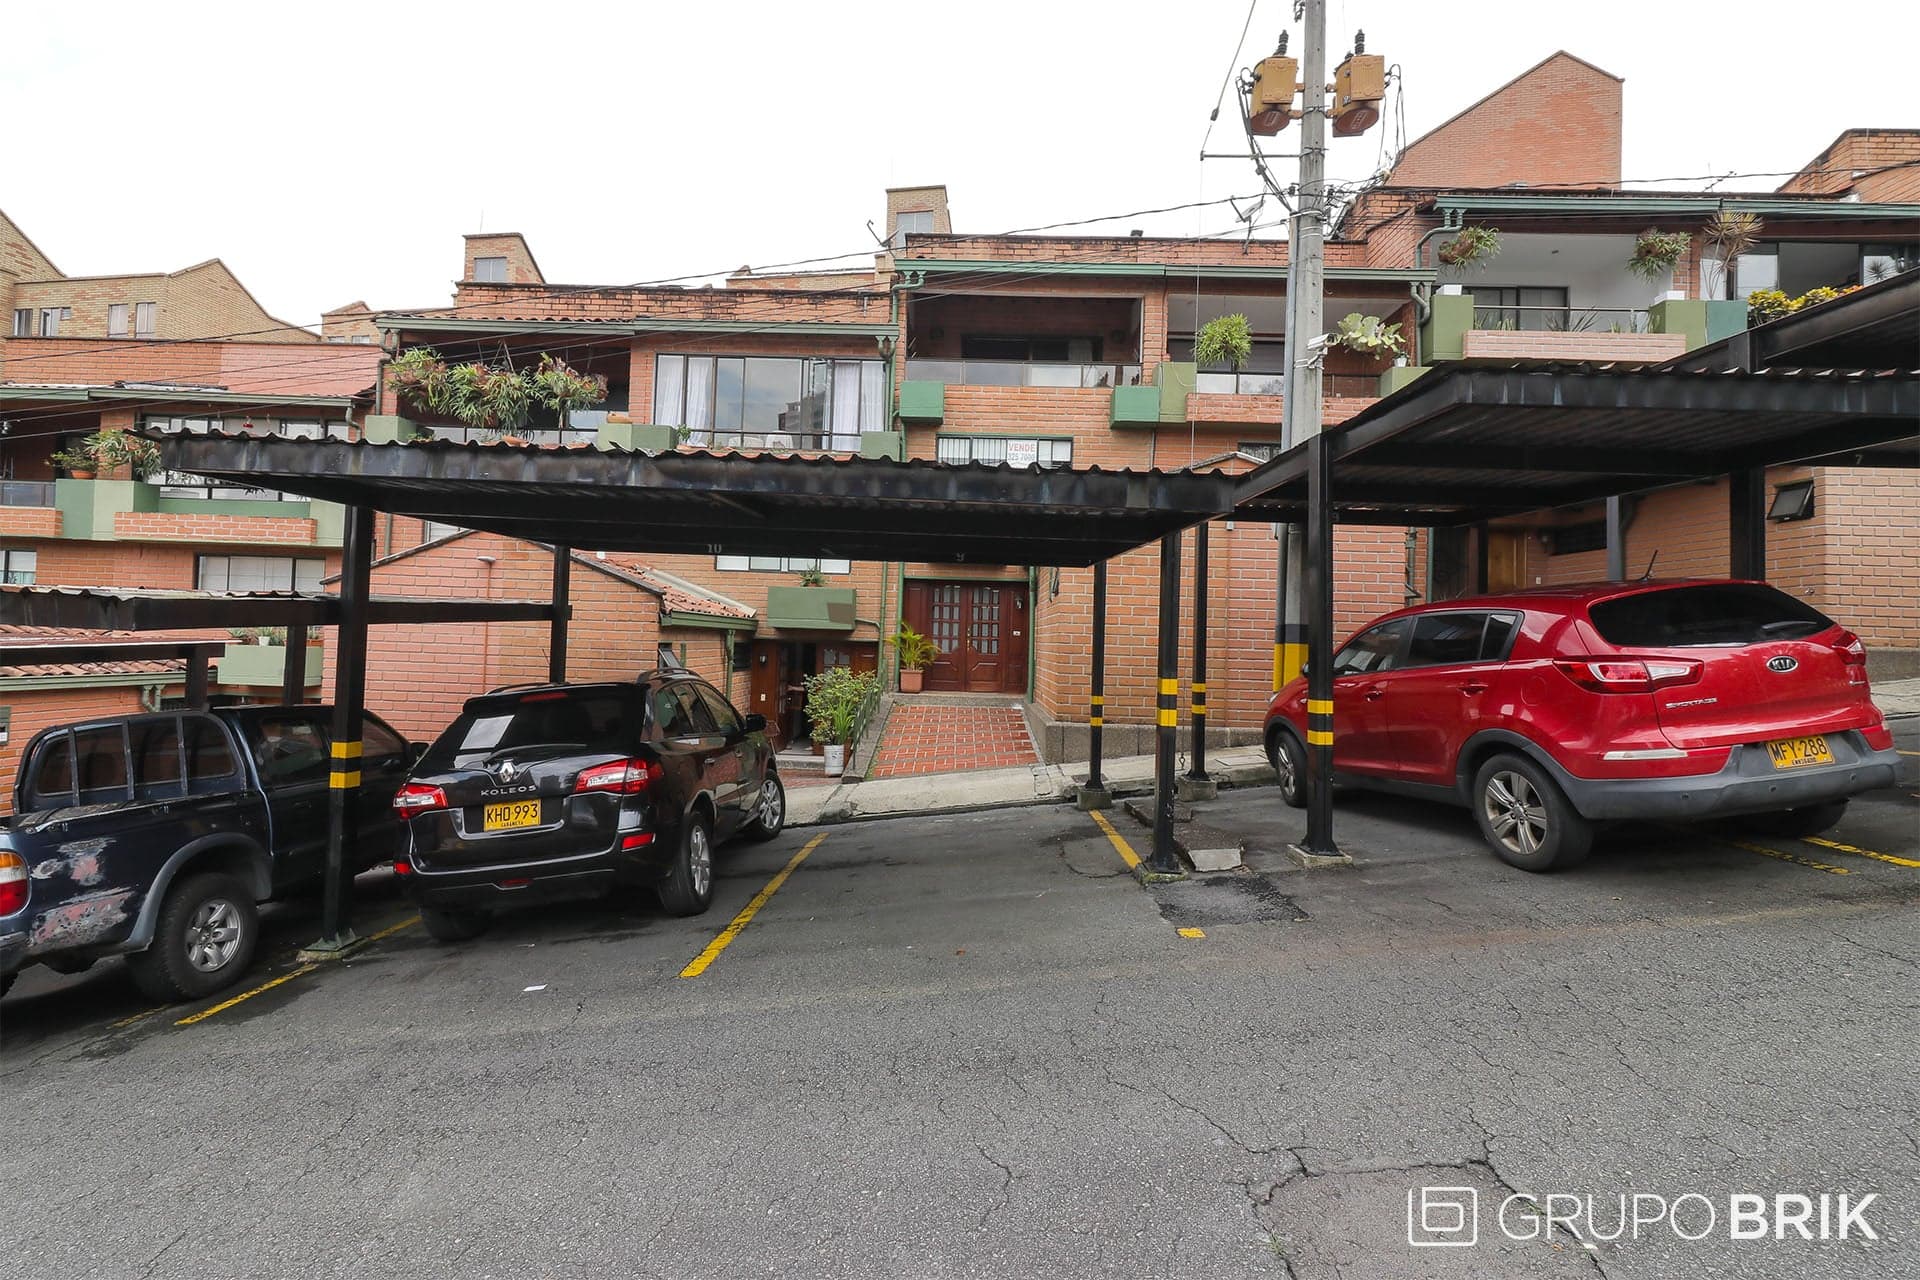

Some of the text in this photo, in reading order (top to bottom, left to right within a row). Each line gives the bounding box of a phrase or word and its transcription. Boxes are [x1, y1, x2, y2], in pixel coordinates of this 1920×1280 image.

[1008, 442, 1036, 453] VENDE
[707, 543, 722, 554] 10
[1771, 659, 1795, 670] KIA
[480, 785, 537, 796] KOLEOS
